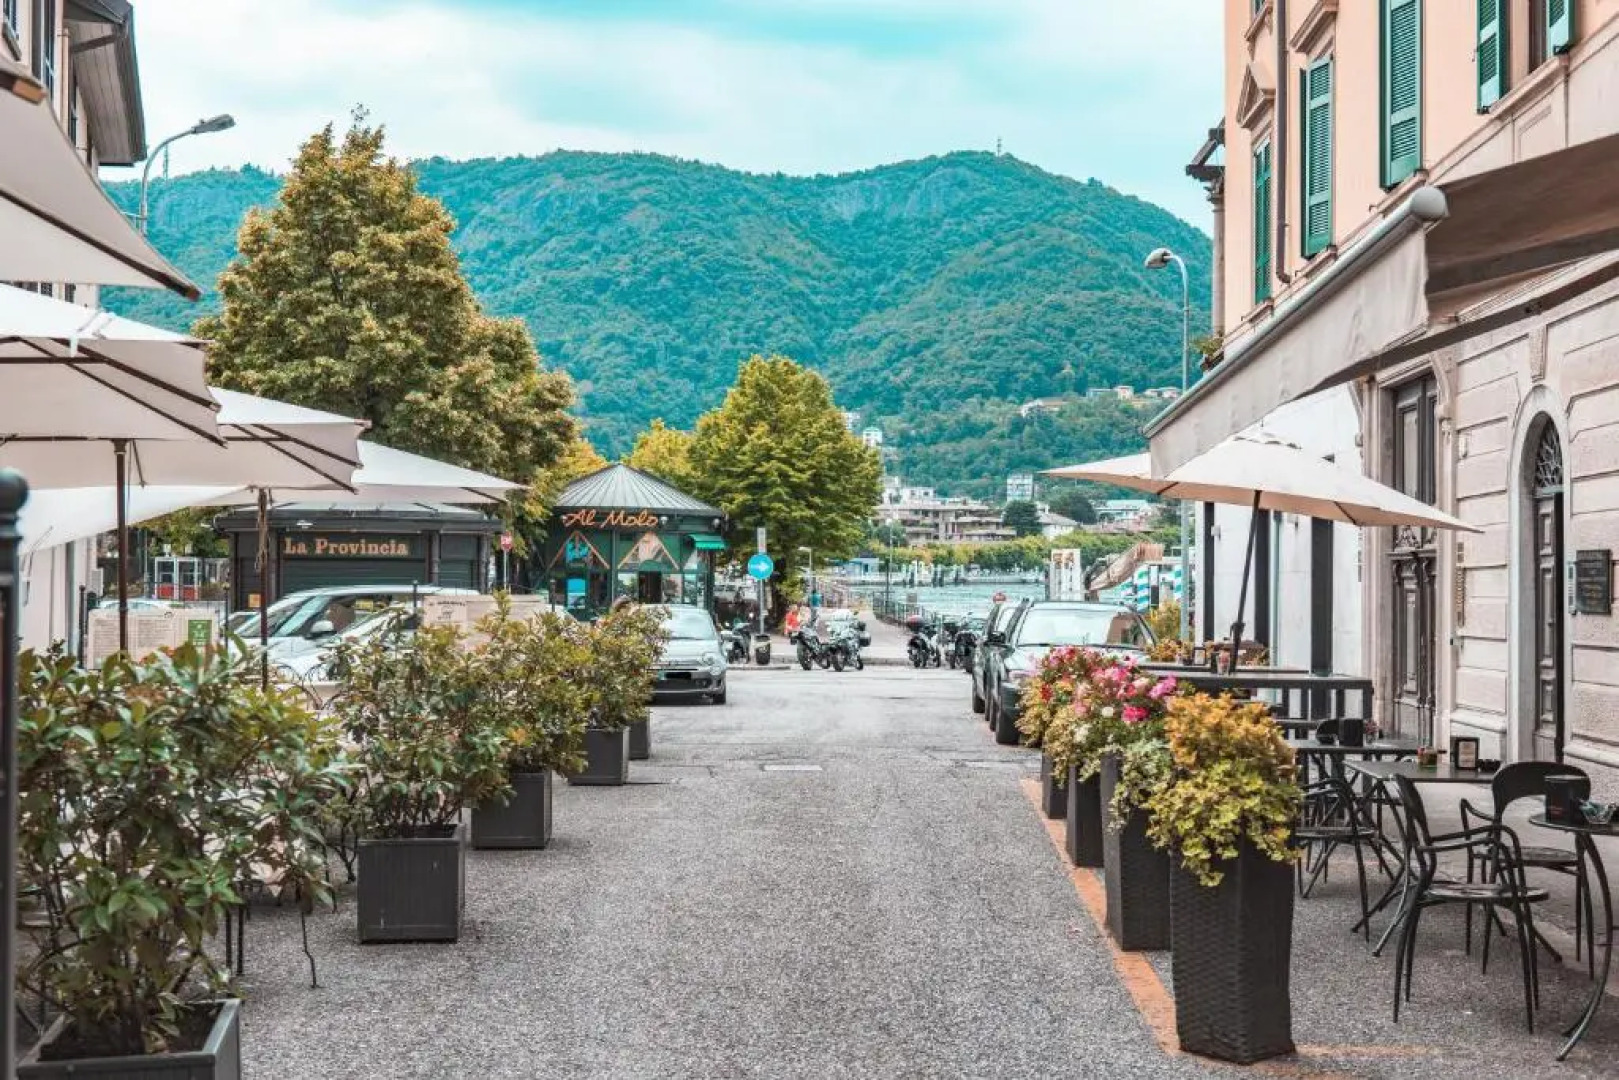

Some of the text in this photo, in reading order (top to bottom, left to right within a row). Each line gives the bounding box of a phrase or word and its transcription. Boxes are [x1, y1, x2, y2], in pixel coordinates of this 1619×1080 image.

[562, 508, 659, 529] Al Molo
[284, 537, 409, 556] La Provincia
